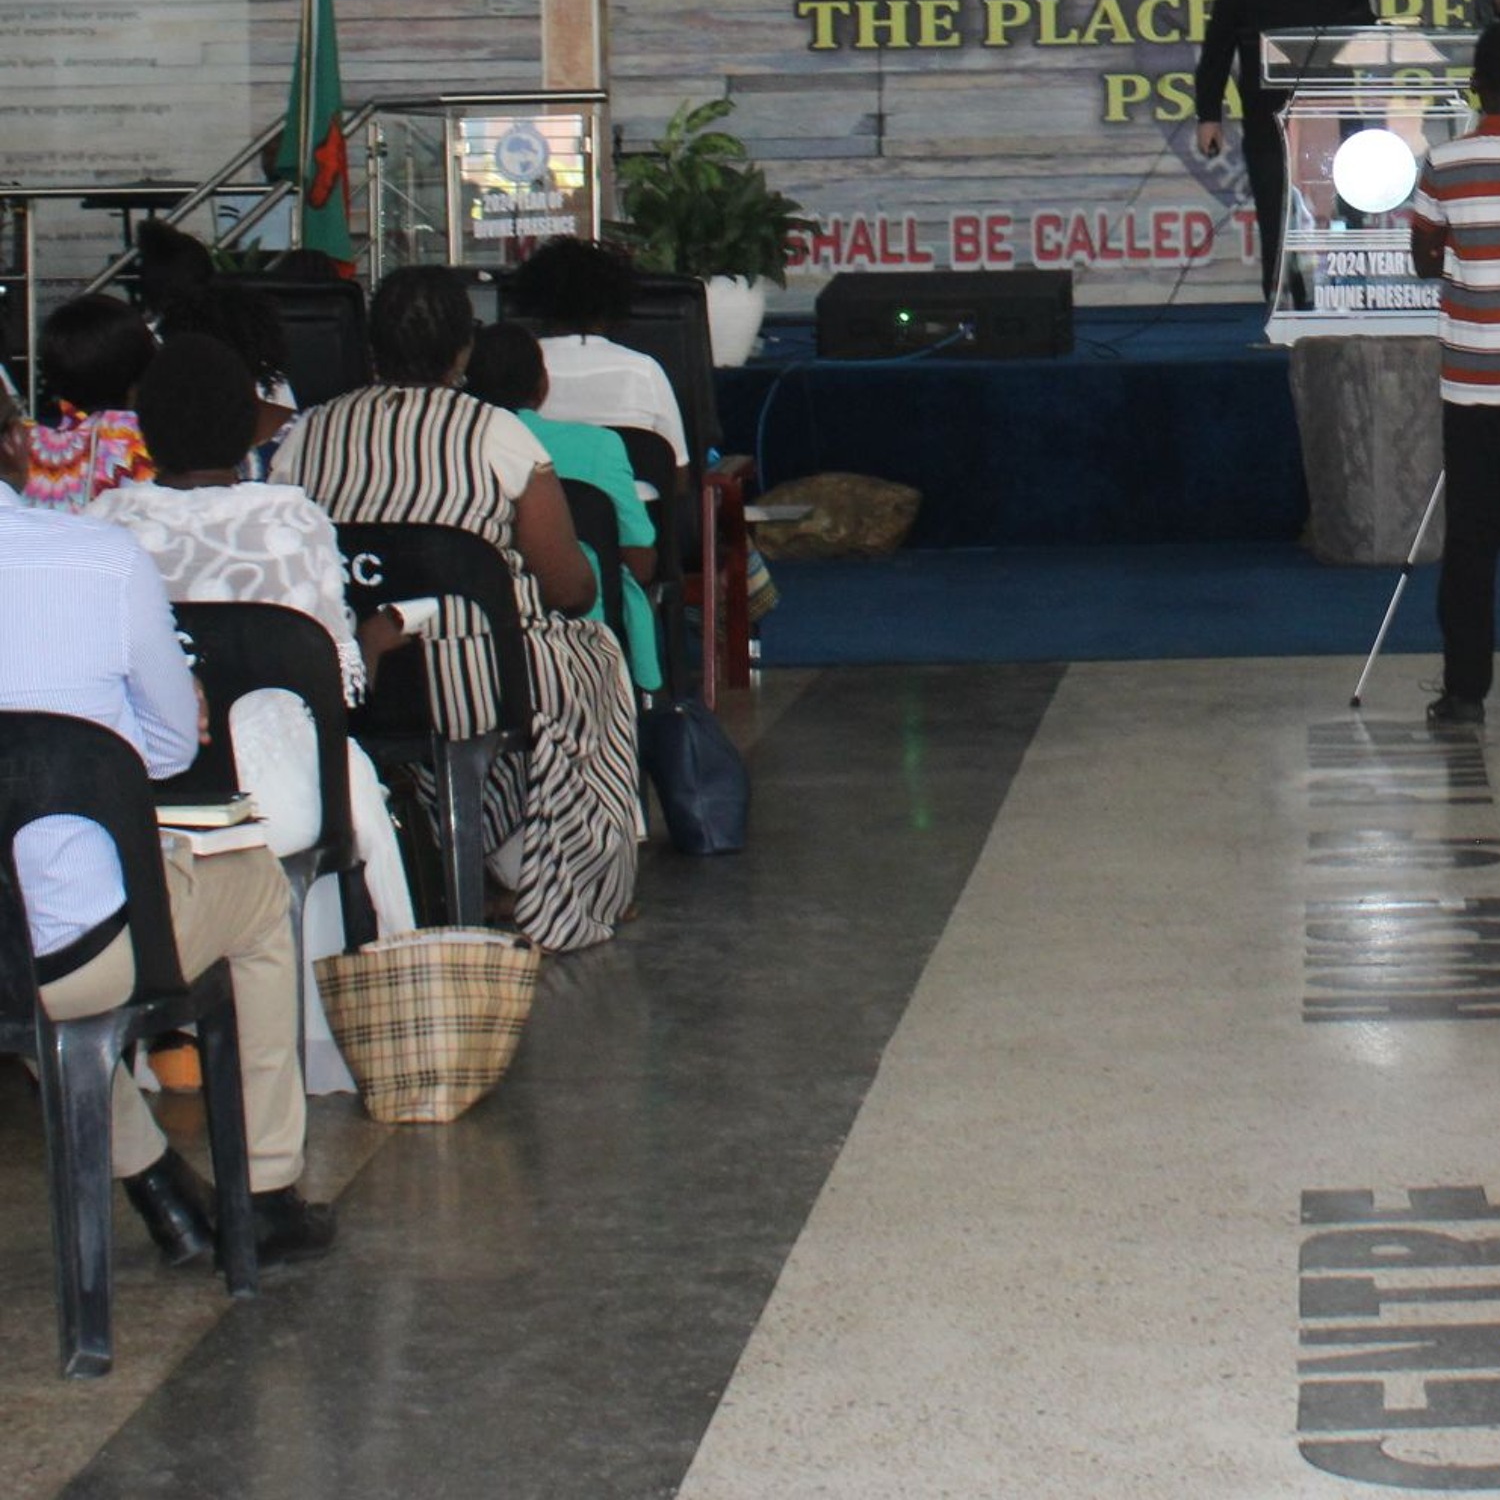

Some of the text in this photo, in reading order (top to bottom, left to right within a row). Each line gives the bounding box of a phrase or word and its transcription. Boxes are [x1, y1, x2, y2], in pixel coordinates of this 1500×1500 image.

[951, 213, 1014, 265] BE
[1034, 210, 1215, 264] CALLED
[1327, 251, 1366, 277] 2024
[1367, 251, 1405, 276] YEAR
[1313, 283, 1441, 310] DIVINE PRESENCE
